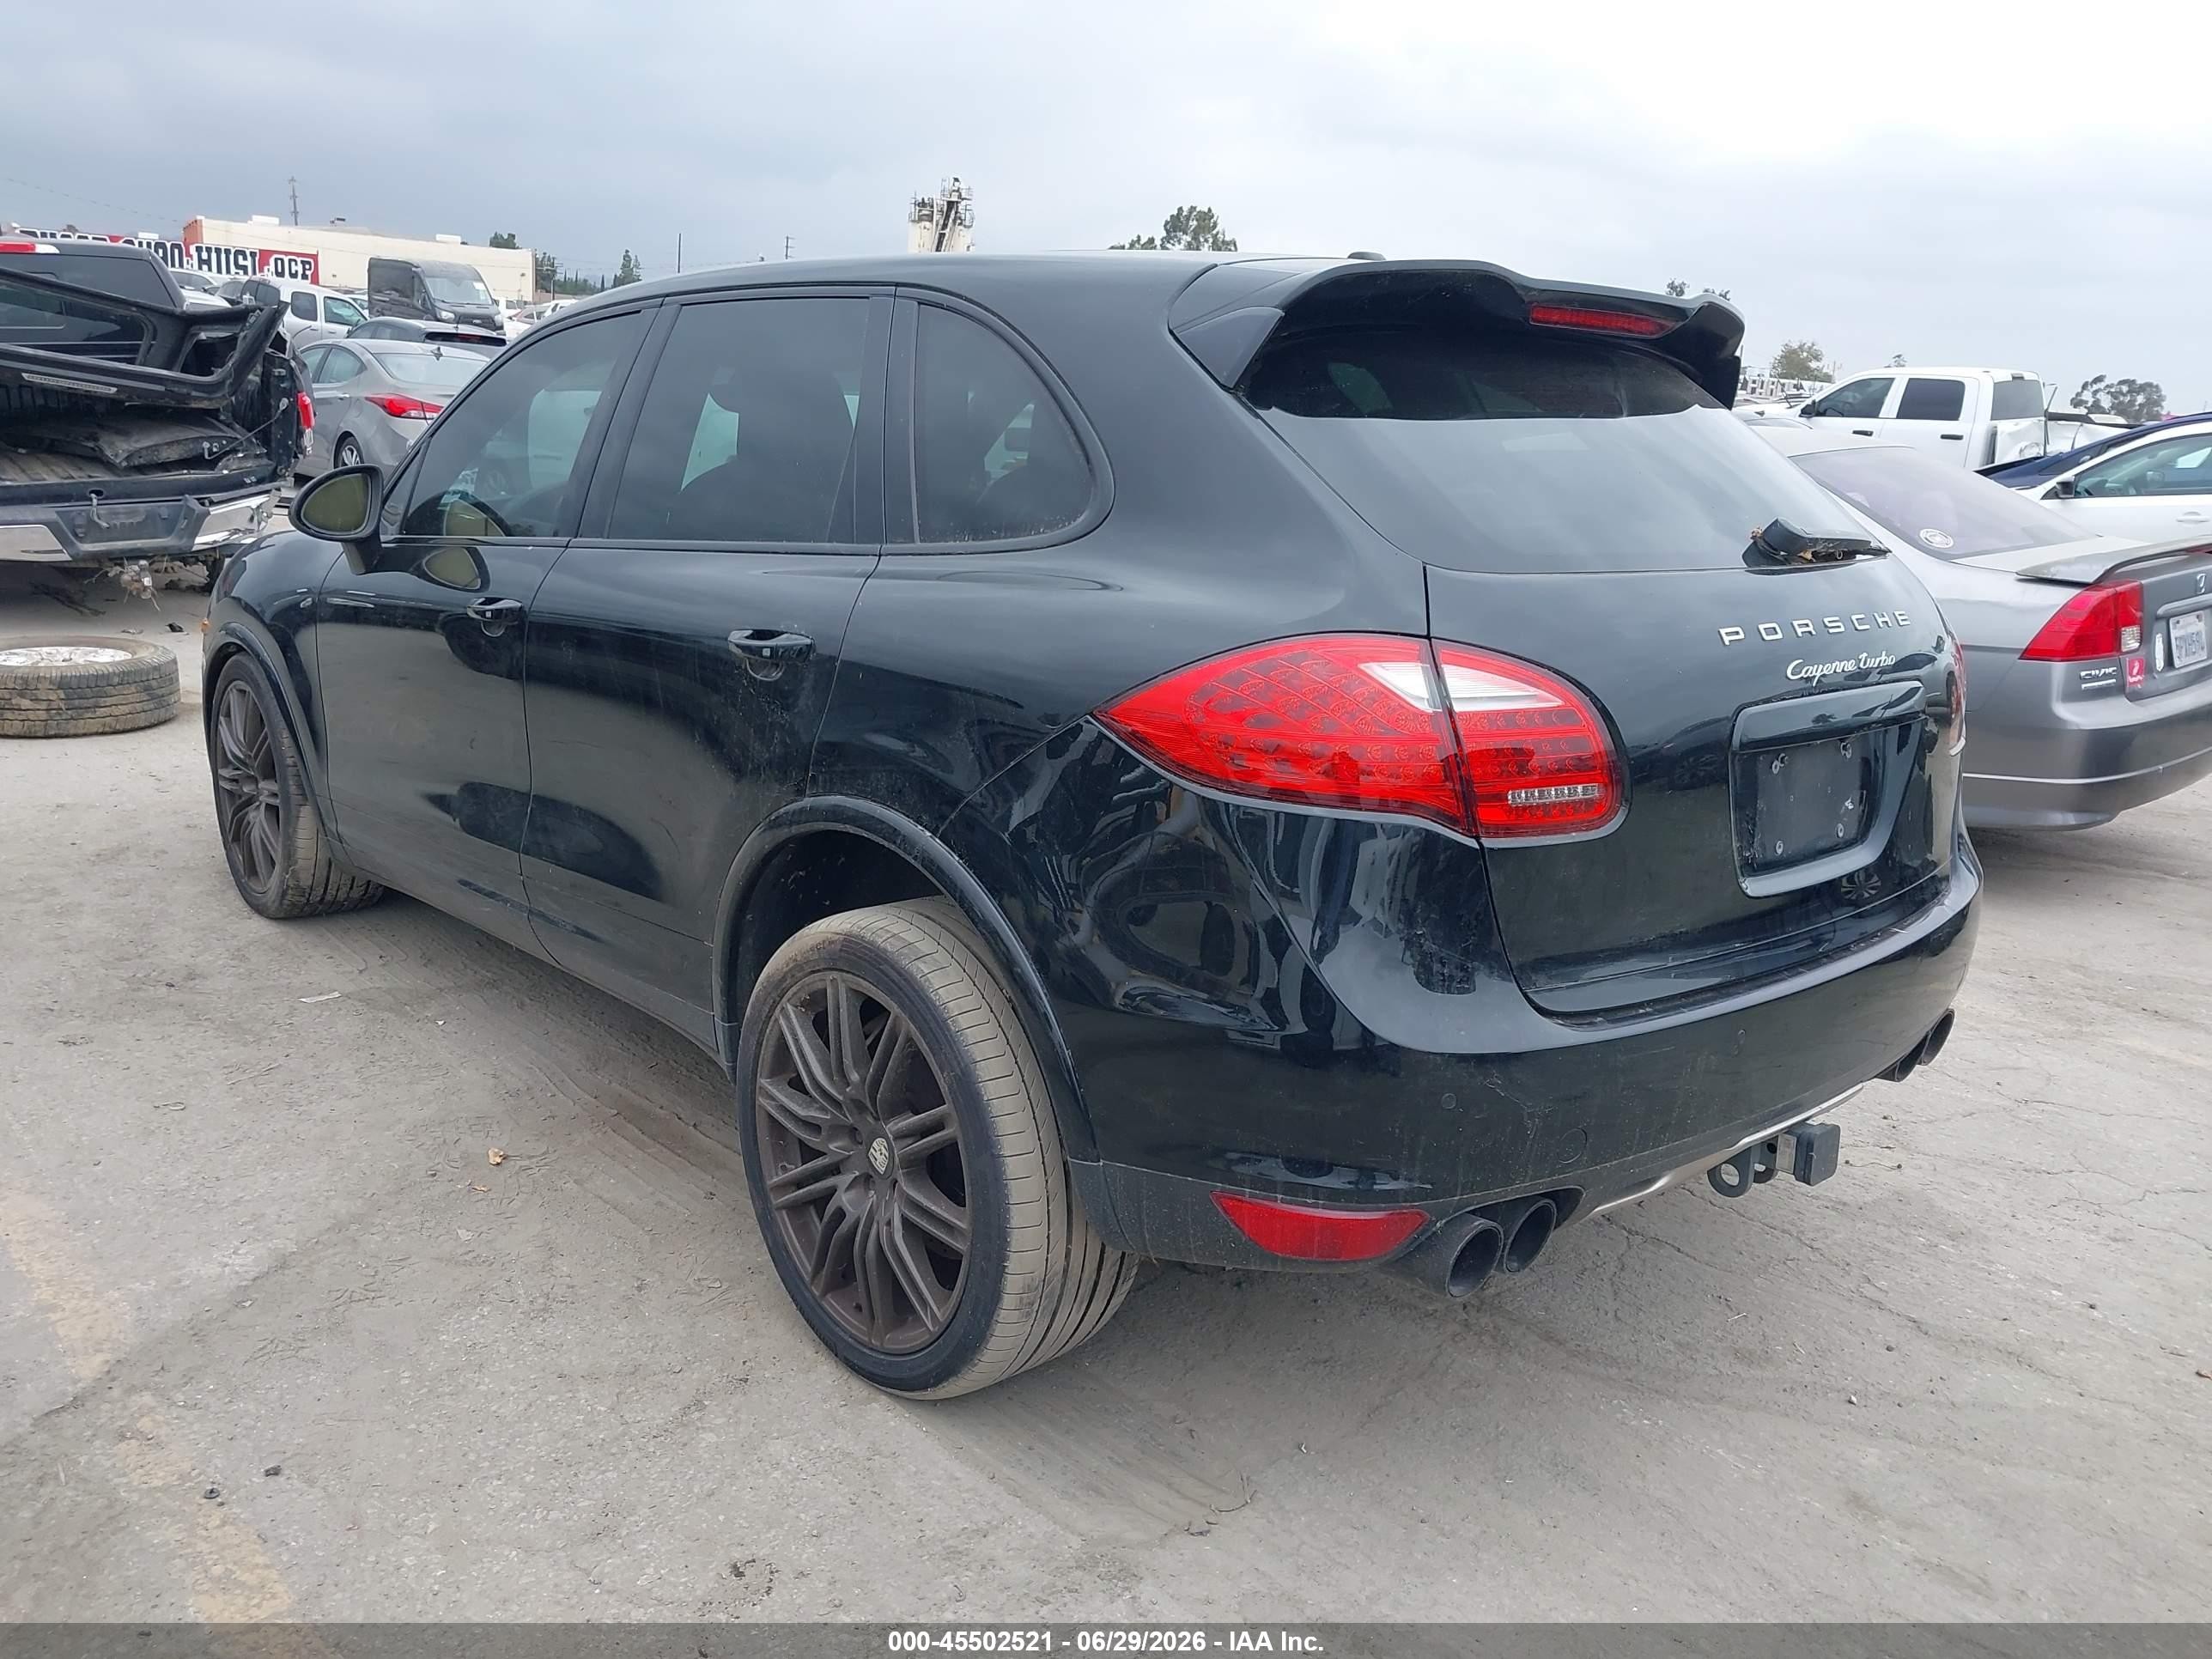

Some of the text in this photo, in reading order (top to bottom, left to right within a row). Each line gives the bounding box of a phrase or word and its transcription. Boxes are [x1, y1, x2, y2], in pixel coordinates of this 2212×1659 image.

[274, 257, 313, 281] OCP
[1718, 611, 1911, 646] PORSCHE
[1786, 659, 1857, 686] Cayenne
